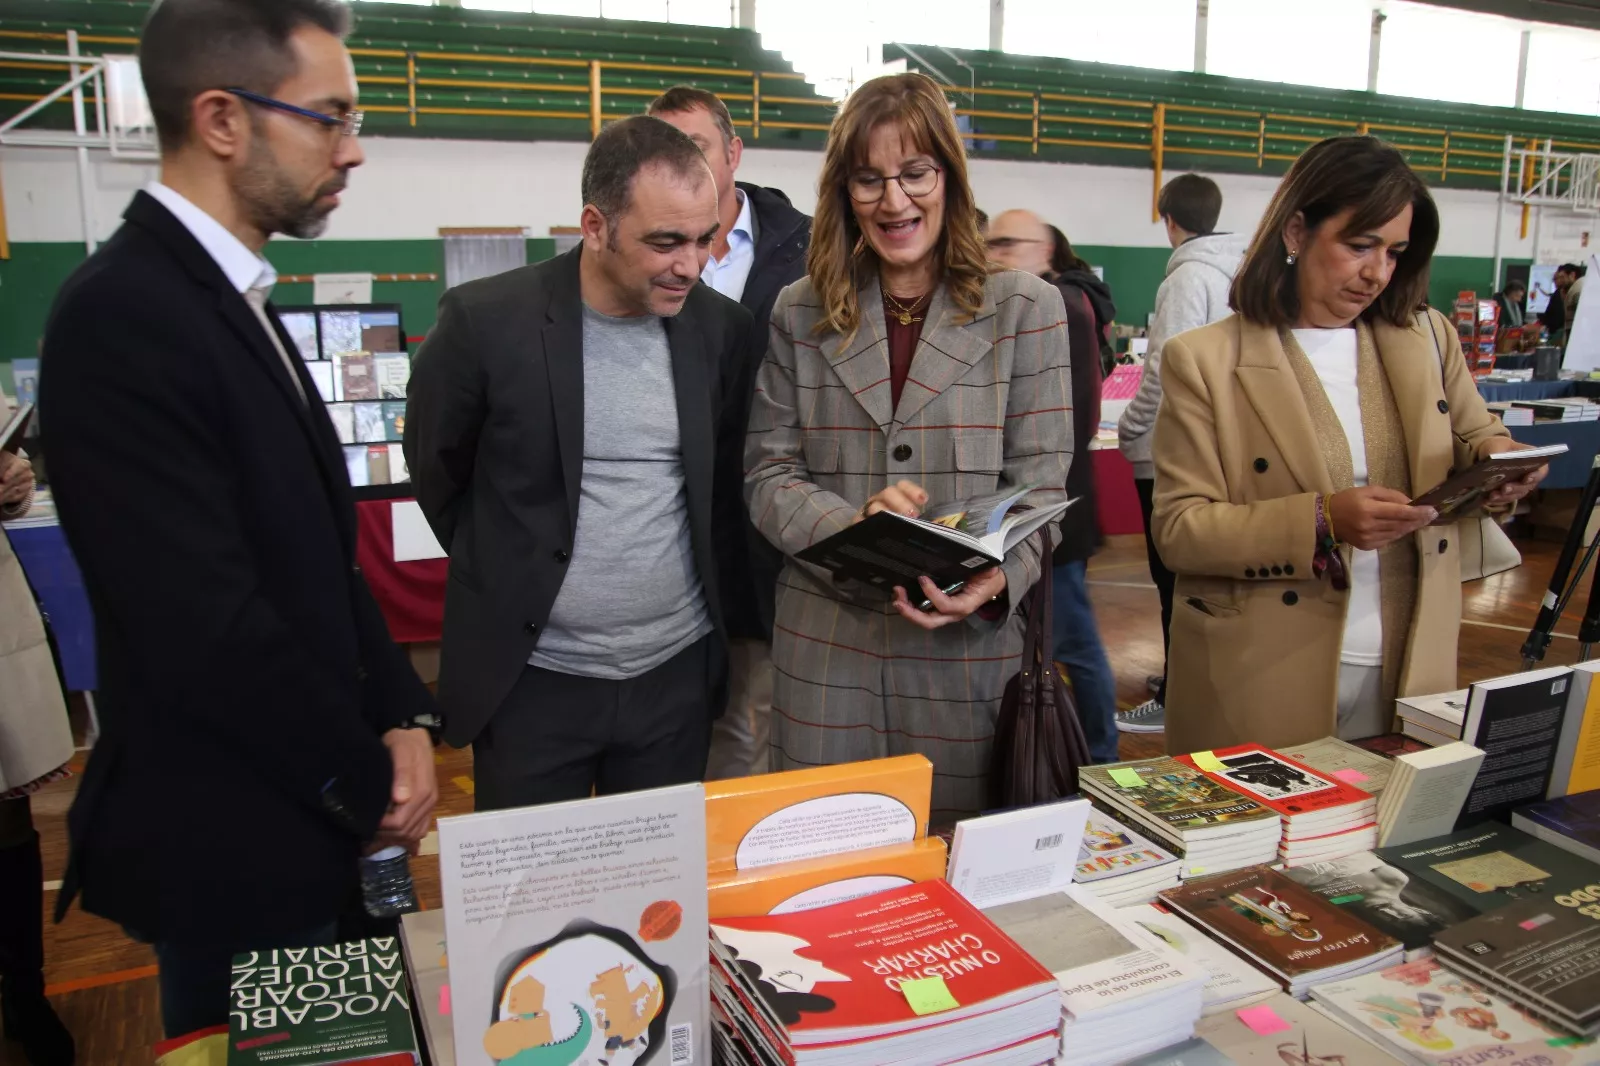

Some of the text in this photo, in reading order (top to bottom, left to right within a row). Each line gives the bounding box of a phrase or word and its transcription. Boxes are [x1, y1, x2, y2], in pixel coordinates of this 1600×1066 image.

[862, 933, 983, 975] CHARRAR
[982, 949, 1001, 965] O
[1286, 931, 1370, 965] Los tres amigos
[1092, 978, 1109, 989] de
[1097, 968, 1182, 998] El relato de la
[1109, 960, 1170, 984] conquista
[230, 970, 402, 1010] ALTOAR
[1062, 981, 1093, 998] Ejea
[336, 1038, 388, 1050] VOCABULARIO
